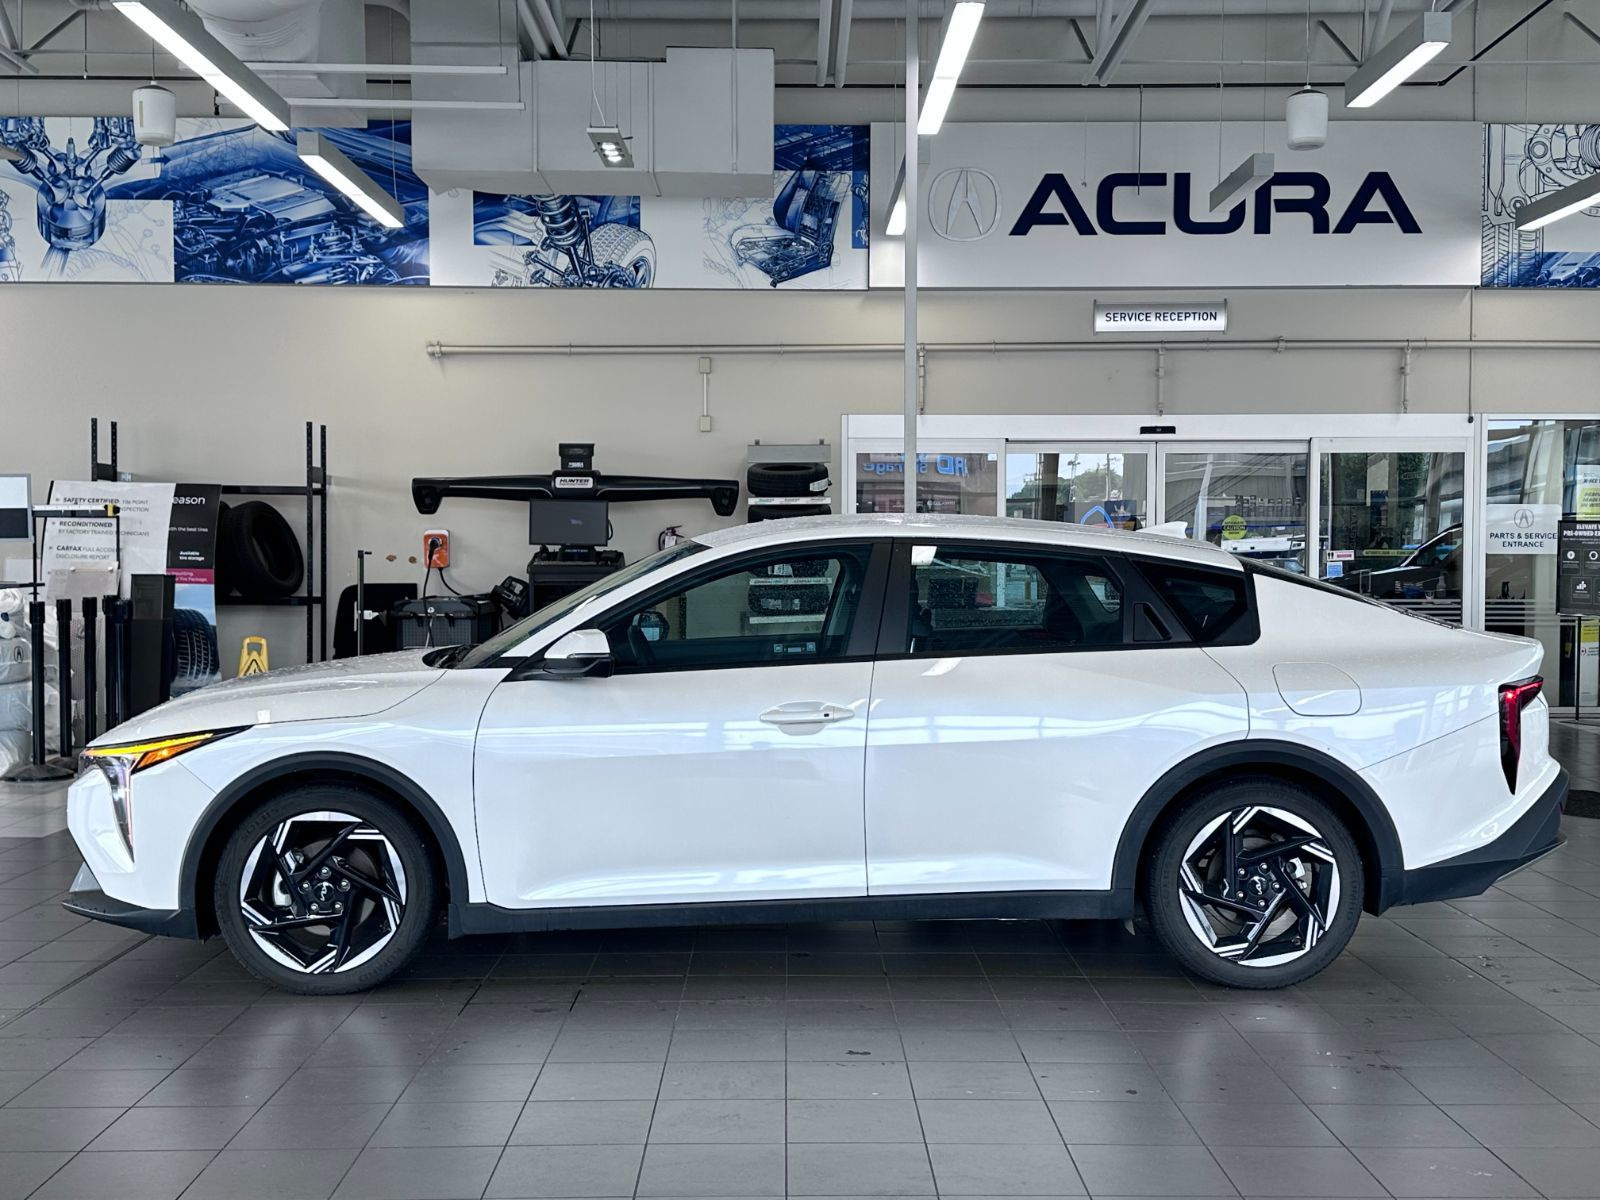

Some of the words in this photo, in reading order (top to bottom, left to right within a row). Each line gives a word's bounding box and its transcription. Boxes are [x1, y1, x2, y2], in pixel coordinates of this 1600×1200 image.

[1008, 171, 1423, 236] ACURA
[1105, 312, 1152, 322] SERVICE
[1154, 311, 1218, 321] RECEPTION
[172, 496, 206, 505] eason
[1223, 524, 1246, 532] CAUTION
[1489, 532, 1515, 540] PARTS
[1516, 532, 1522, 540] &
[1524, 532, 1558, 540] SERVICE
